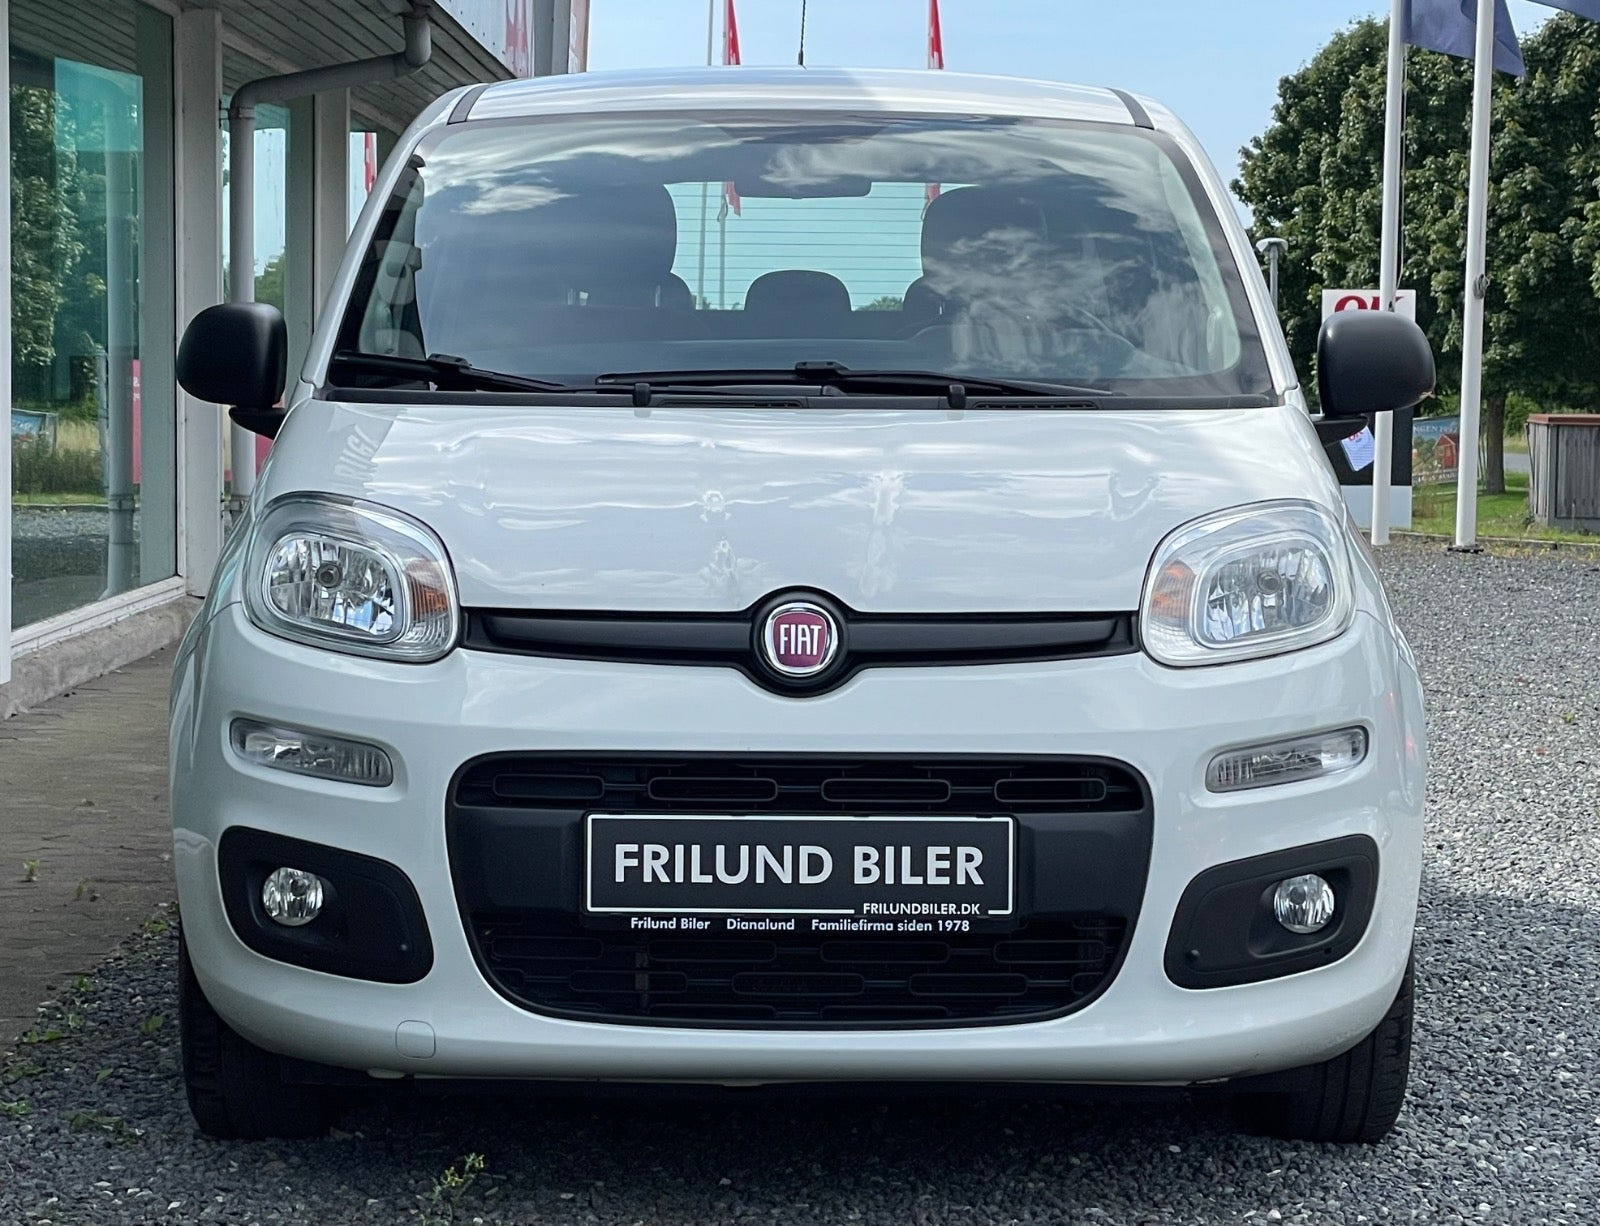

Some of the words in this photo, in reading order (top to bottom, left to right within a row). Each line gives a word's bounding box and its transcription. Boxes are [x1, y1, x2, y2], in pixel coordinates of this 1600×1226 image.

[779, 624, 822, 656] FIAT
[614, 843, 834, 886] FRILUND
[853, 845, 985, 886] BILER
[862, 902, 981, 915] FRILUNDBILER.DK
[630, 916, 677, 930] Frilund
[680, 917, 711, 931] Biler
[726, 918, 796, 931] Dianalund
[811, 918, 894, 932] Familiefirma
[897, 919, 933, 932] siden
[937, 919, 970, 932] 1978
